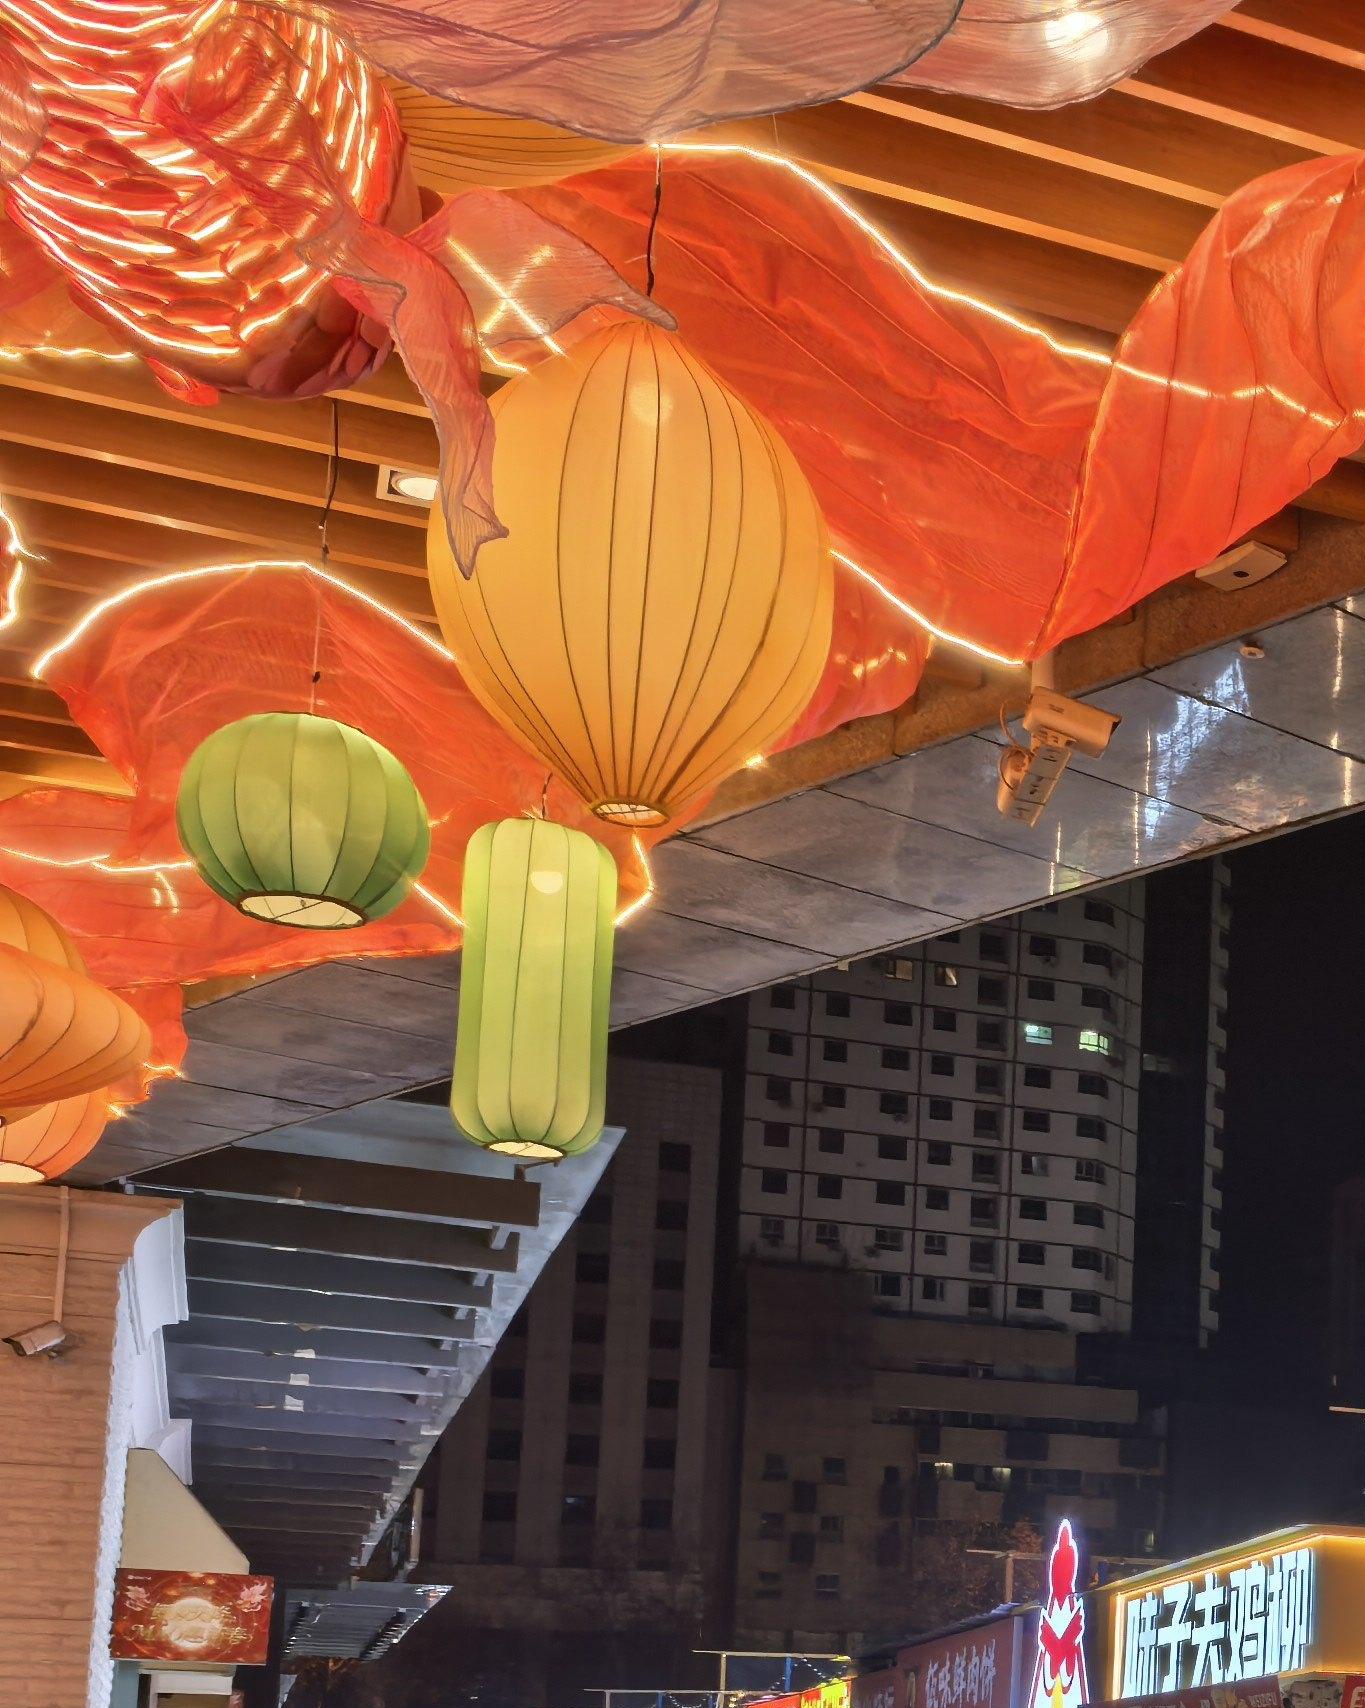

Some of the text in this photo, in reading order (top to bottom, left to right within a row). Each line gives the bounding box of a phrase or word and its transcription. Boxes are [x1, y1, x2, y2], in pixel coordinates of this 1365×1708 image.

[1121, 1548, 1313, 1700] 味子夫鸡柳
